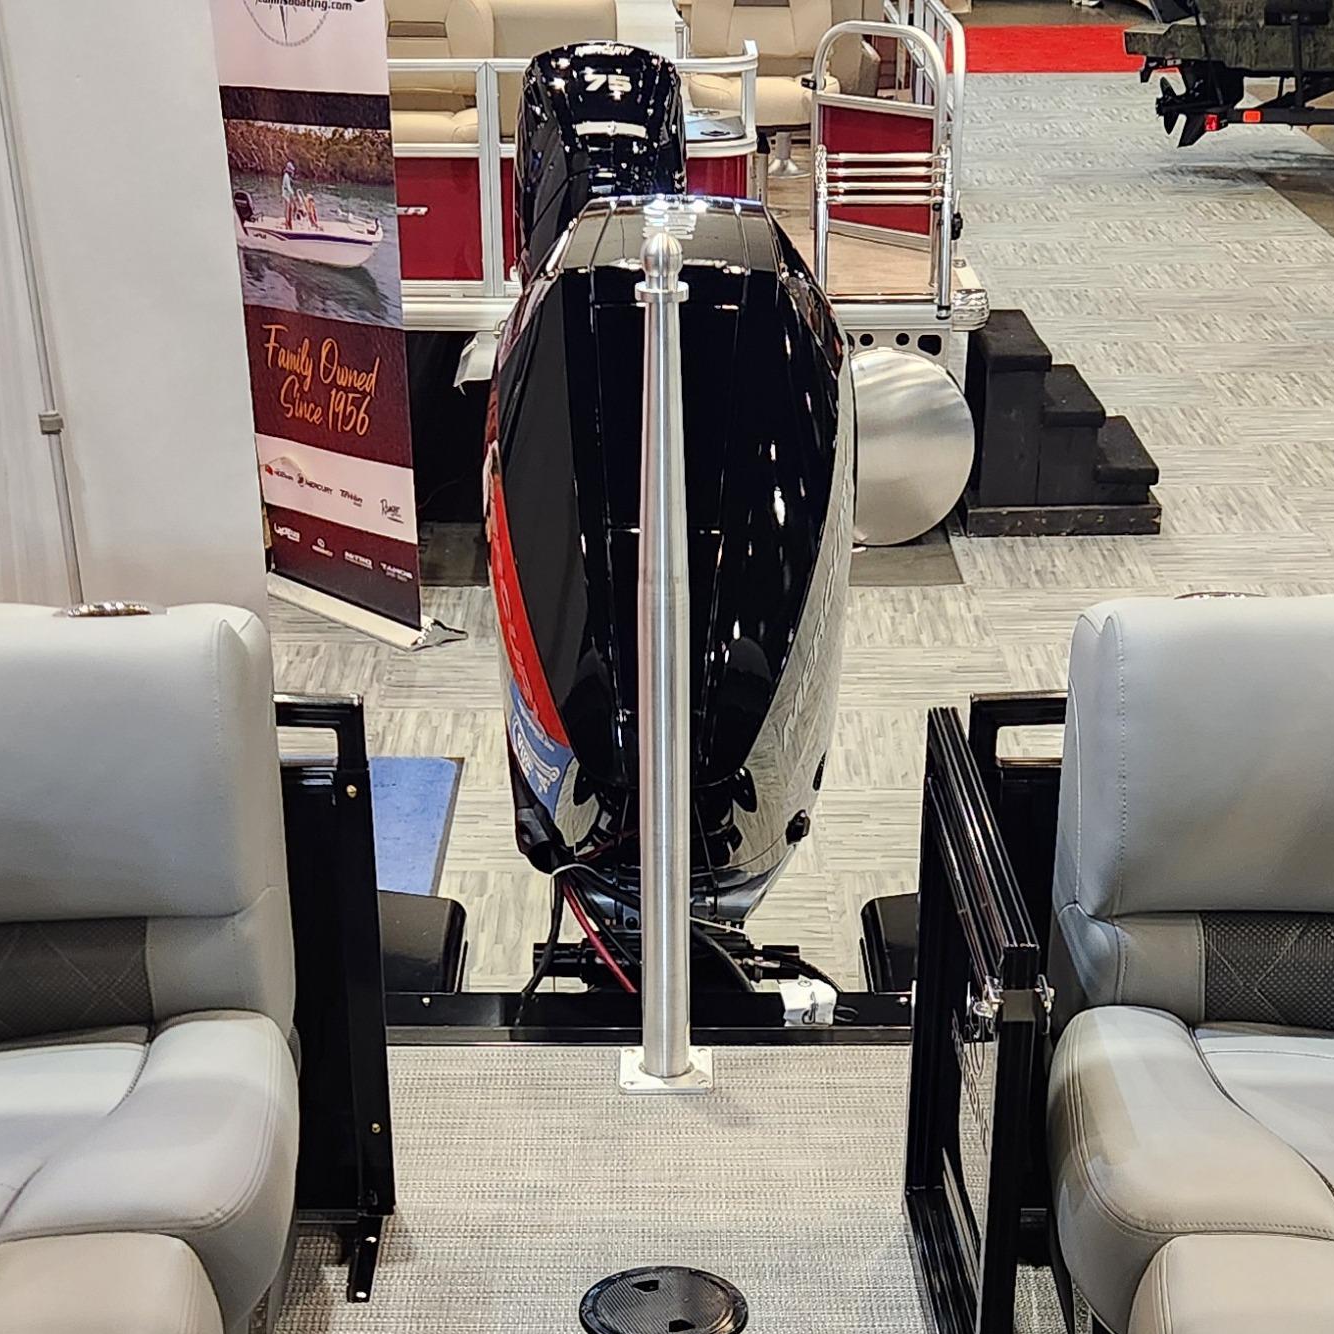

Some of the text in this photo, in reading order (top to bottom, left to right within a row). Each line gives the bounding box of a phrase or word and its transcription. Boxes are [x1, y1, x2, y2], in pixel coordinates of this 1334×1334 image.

[584, 74, 632, 92] 75
[262, 323, 381, 398] Family Owned
[280, 374, 371, 436] Since 1956
